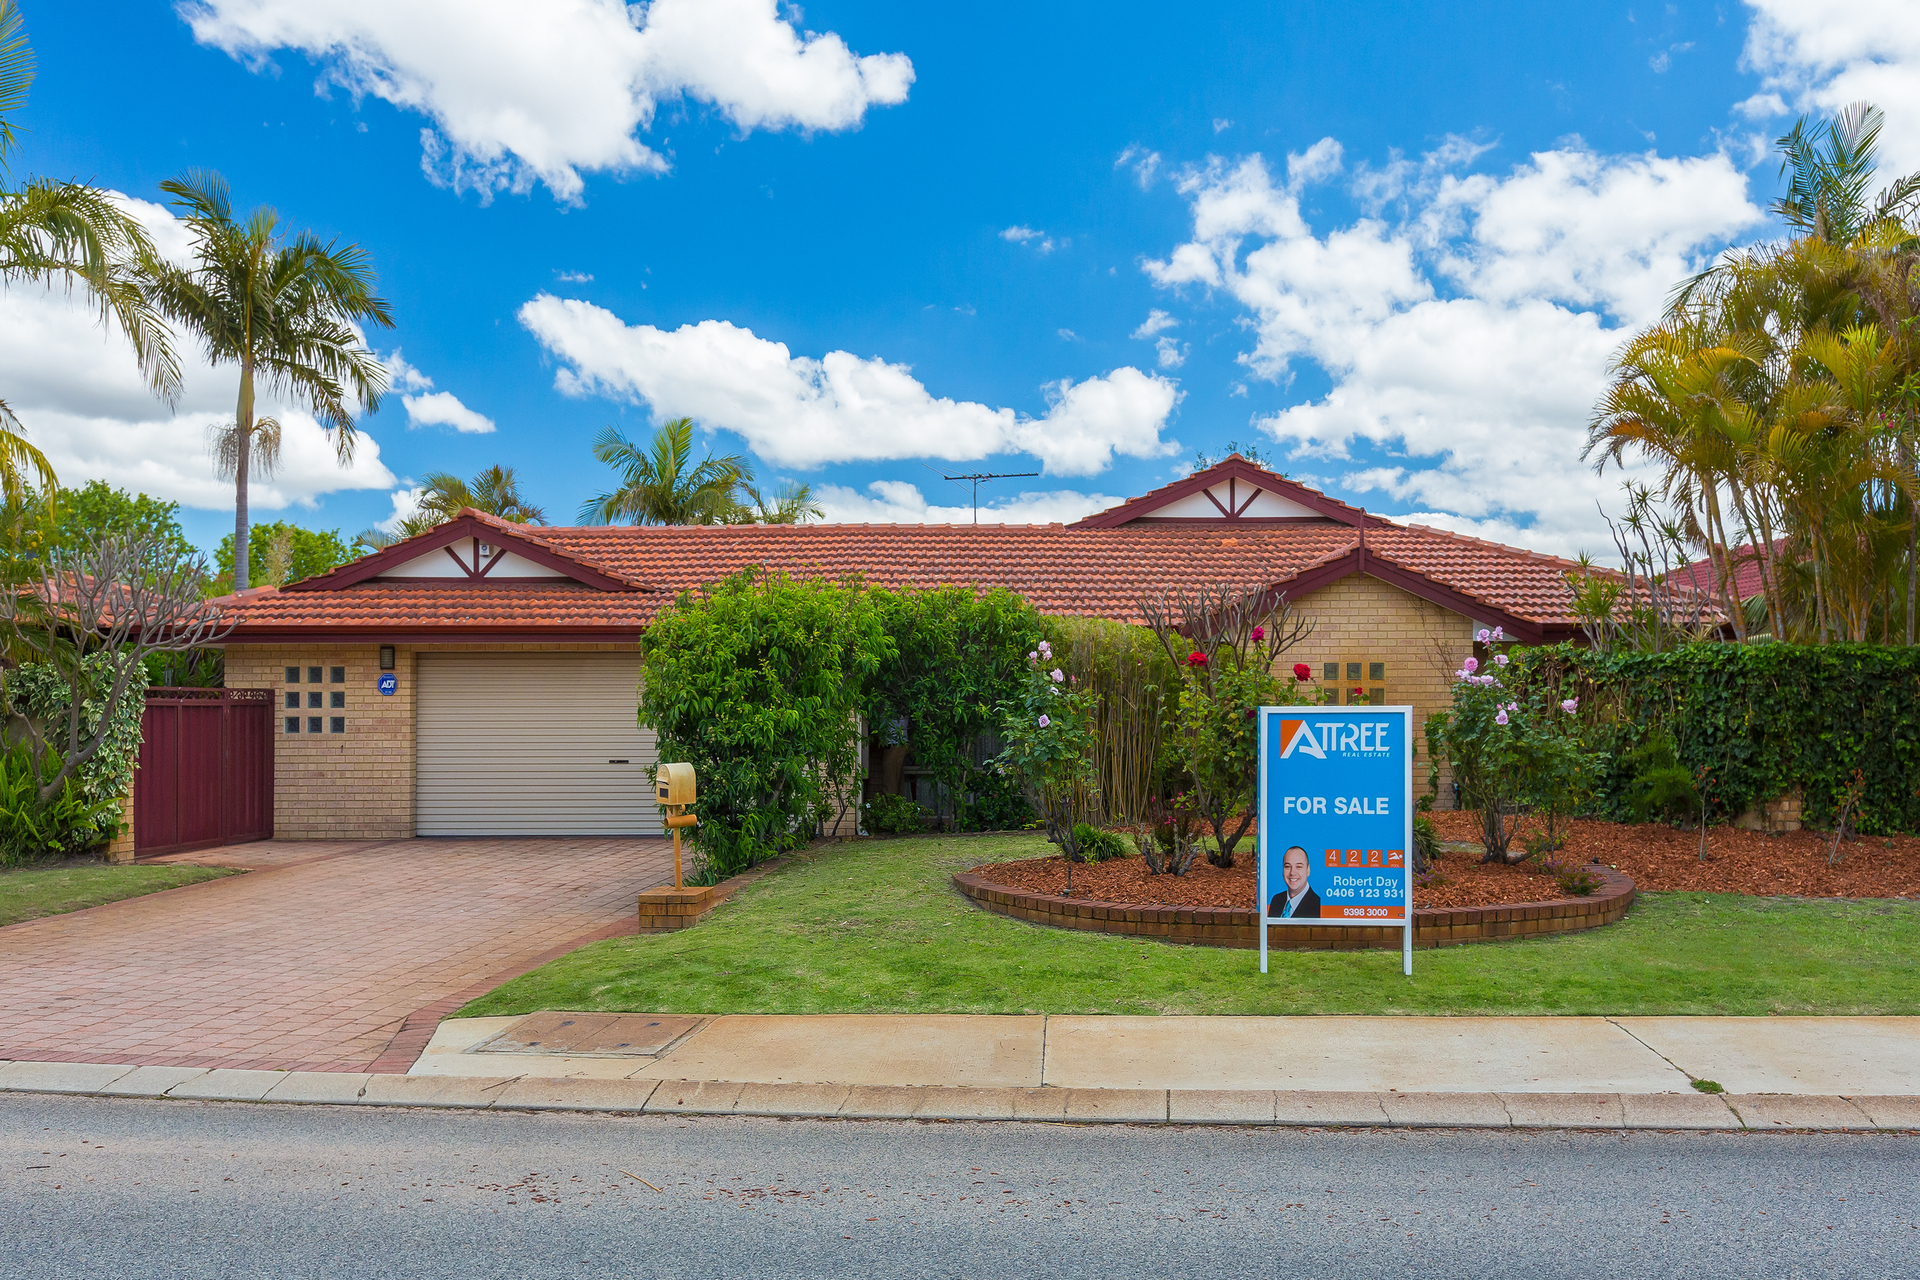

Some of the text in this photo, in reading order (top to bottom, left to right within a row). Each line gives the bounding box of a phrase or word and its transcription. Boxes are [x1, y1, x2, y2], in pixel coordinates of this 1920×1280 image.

[381, 680, 395, 689] ADT
[1280, 720, 1390, 759] ATTREE
[1284, 797, 1389, 815] FOR SALE
[1329, 850, 1378, 862] 4 2 2
[1333, 876, 1398, 888] Robert Day
[1326, 888, 1404, 898] 0406 123 931
[1343, 908, 1388, 917] 9398 3000
